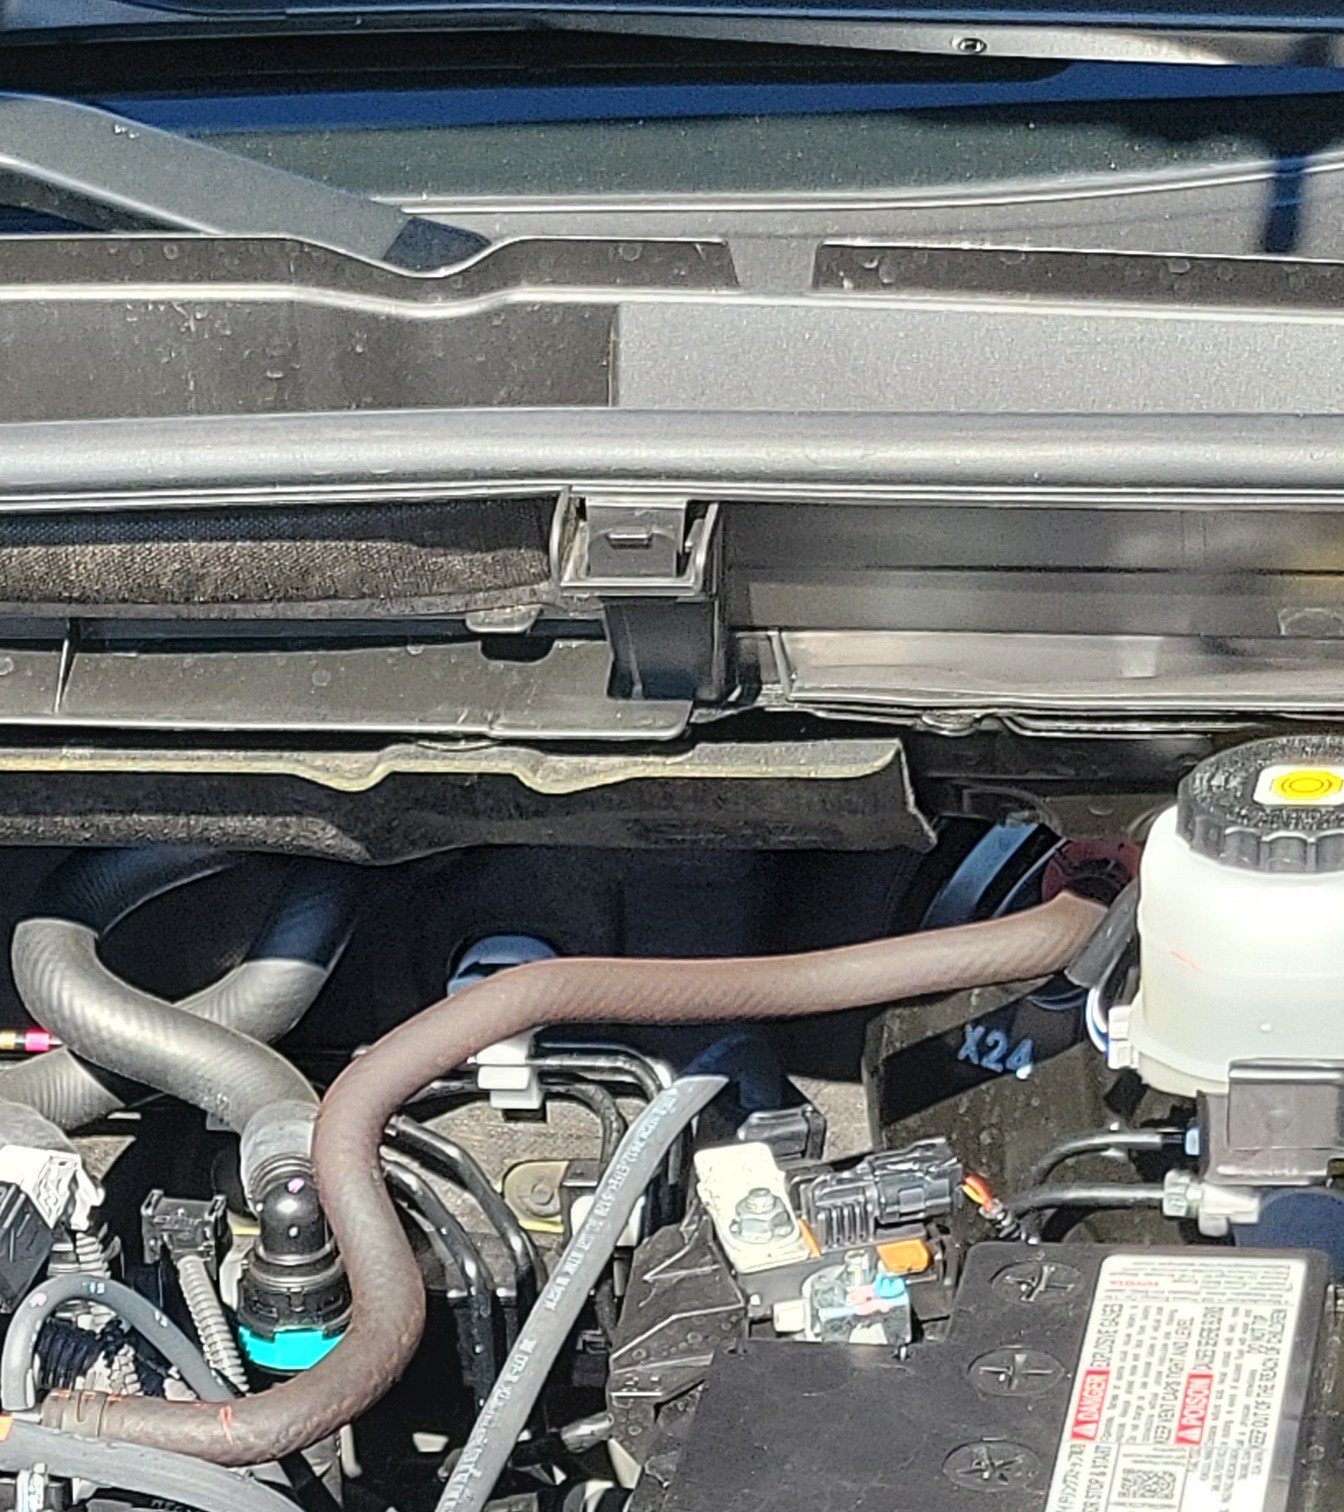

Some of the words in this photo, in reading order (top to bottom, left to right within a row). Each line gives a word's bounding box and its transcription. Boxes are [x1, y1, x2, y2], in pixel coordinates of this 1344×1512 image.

[957, 1023, 1035, 1080] X24
[1077, 1372, 1108, 1421] DANGER
[1181, 1379, 1210, 1426] POISON
[1090, 1445, 1111, 1469] START
[1084, 1478, 1104, 1499] STOP
